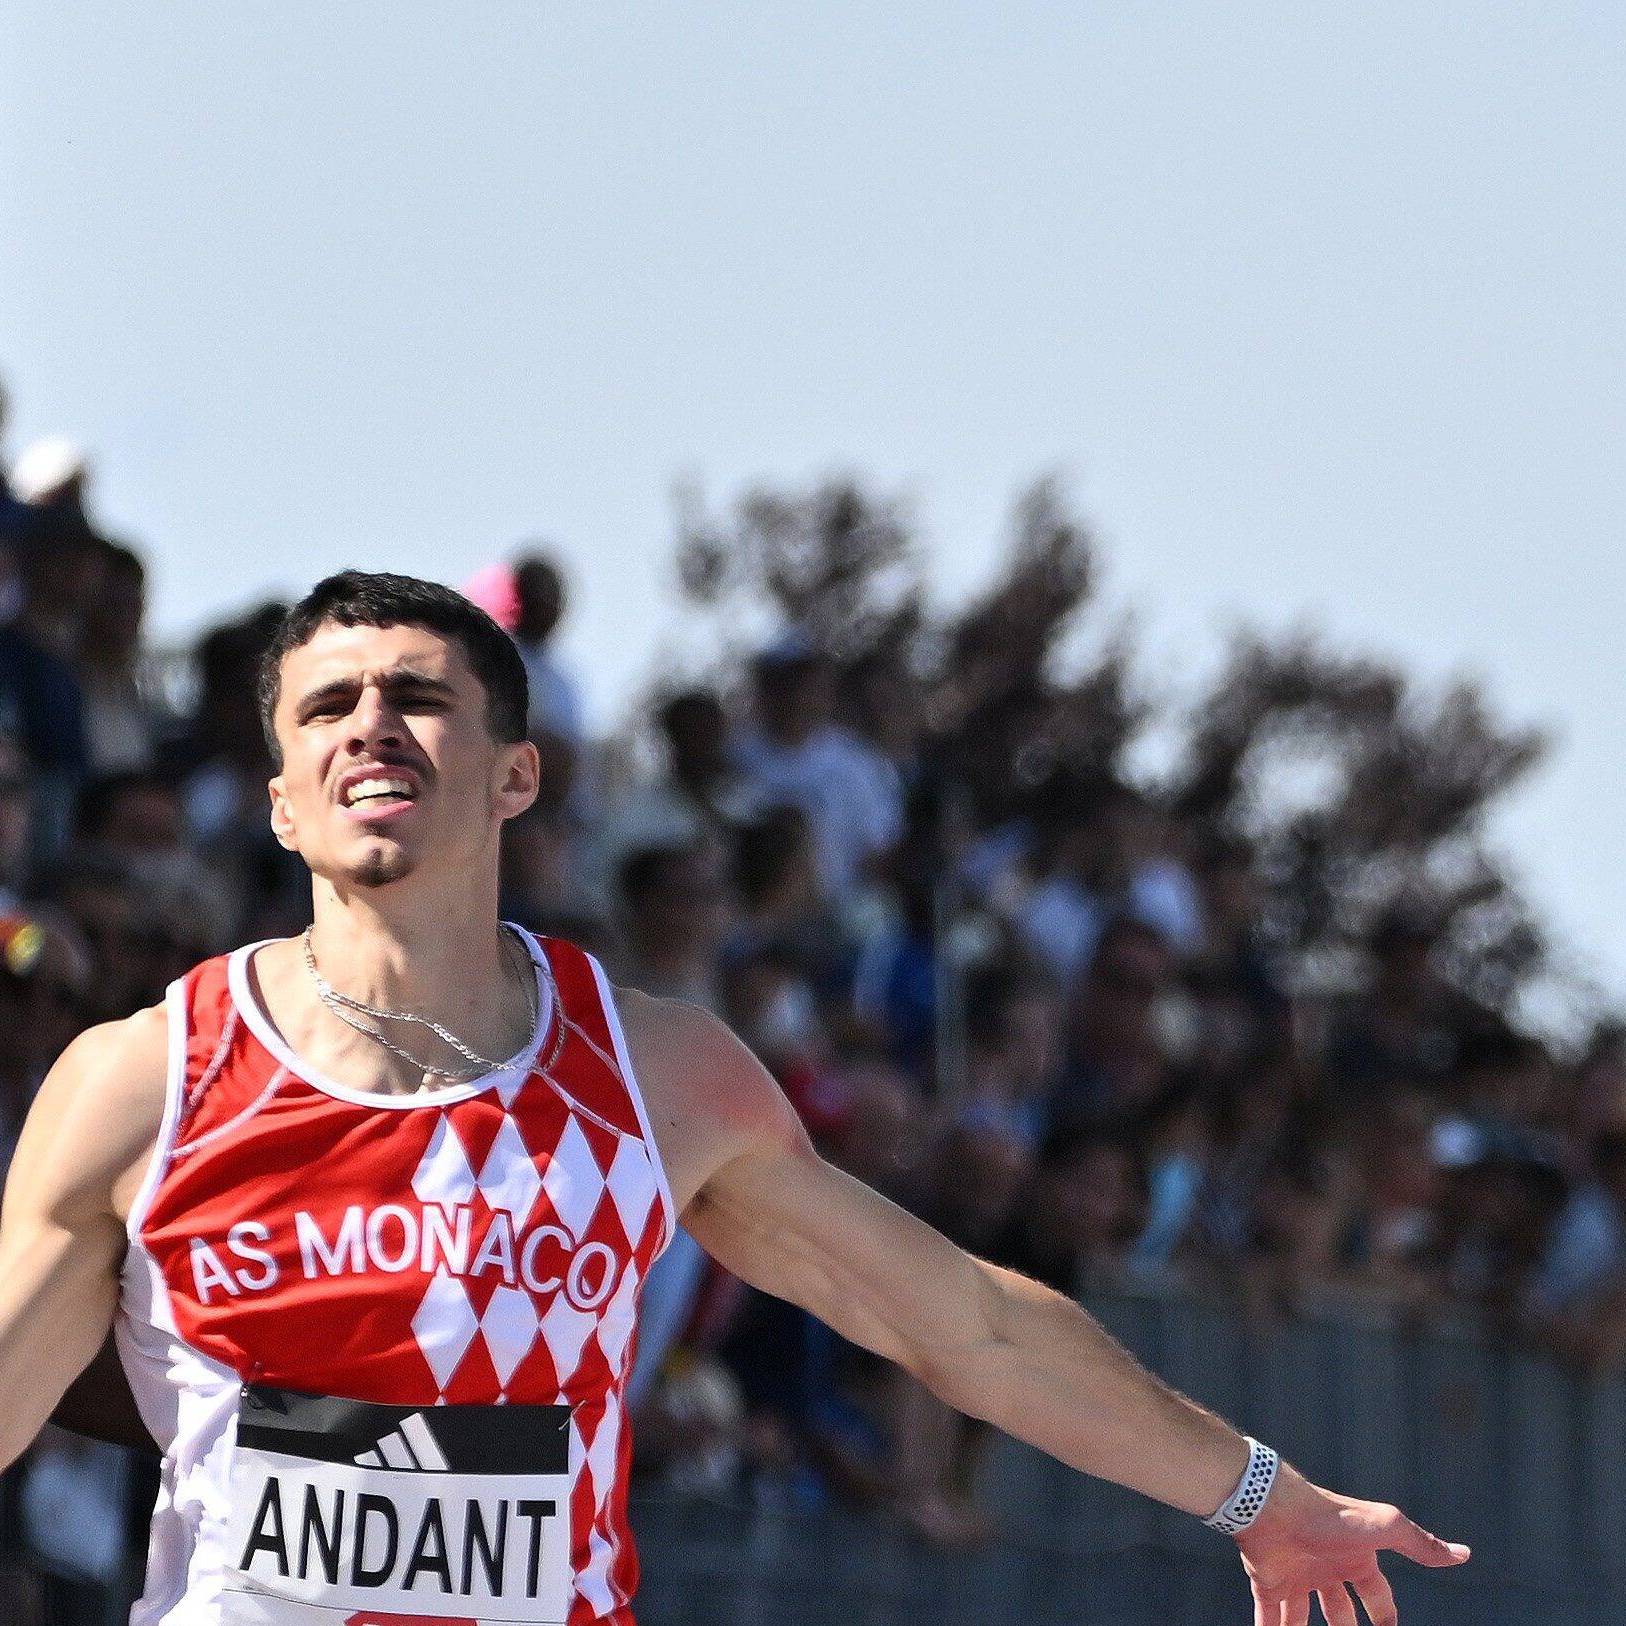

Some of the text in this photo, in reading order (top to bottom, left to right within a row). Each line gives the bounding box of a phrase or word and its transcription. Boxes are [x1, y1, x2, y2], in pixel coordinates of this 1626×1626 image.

[189, 1203, 622, 1310] AS MONACO
[238, 1475, 557, 1599] ANDANT
